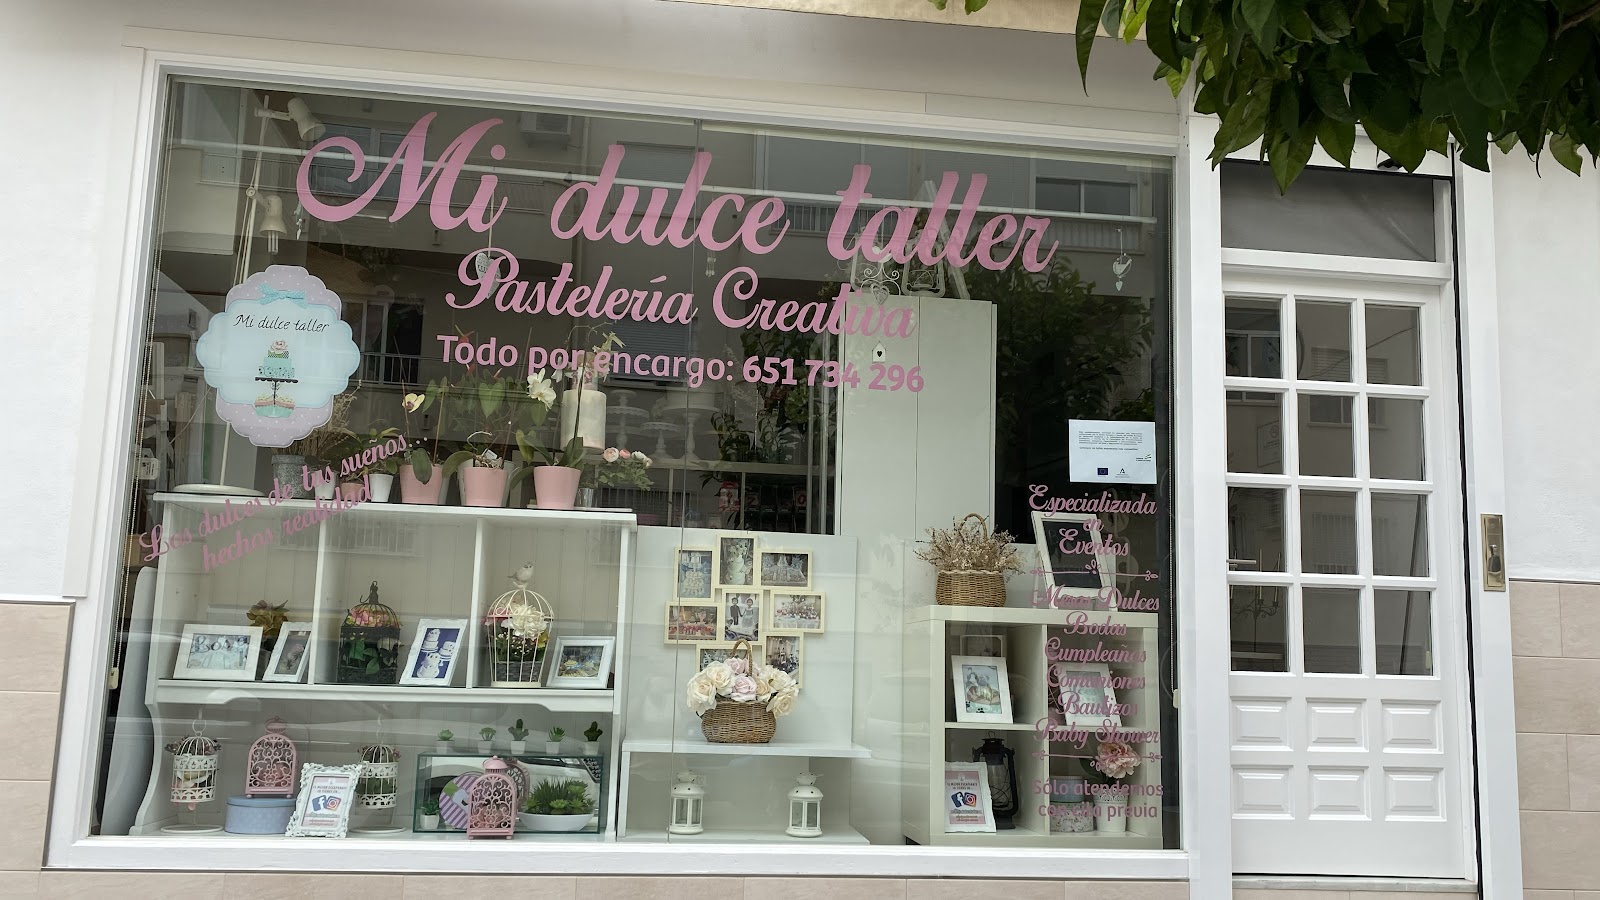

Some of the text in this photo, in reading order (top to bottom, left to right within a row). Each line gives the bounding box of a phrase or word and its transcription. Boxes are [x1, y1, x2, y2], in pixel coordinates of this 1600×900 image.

[296, 112, 1060, 273] Mi dulce taller
[445, 247, 918, 338] Pastelería Creativa
[233, 314, 330, 333] Mi dulce taller
[436, 334, 925, 393] Todo por encargo: 651 734 296
[139, 523, 193, 562] Los
[199, 494, 263, 537] dulces
[268, 478, 294, 507] de
[300, 464, 335, 492] tus
[1028, 484, 1158, 517] Especializada
[202, 474, 373, 572] hechos realidad
[1083, 518, 1104, 532] en
[1059, 528, 1129, 556] Eventos
[1094, 585, 1160, 611] Dulces
[1063, 611, 1127, 636] Bodas
[1045, 636, 1147, 668] Cumpleaños
[1046, 663, 1147, 690] Comuniones
[1055, 690, 1140, 716] Bautizos
[1033, 717, 1160, 749] Baby Shower
[1033, 777, 1164, 797] Sólo atendemos
[1038, 801, 1158, 821] con cita previa
